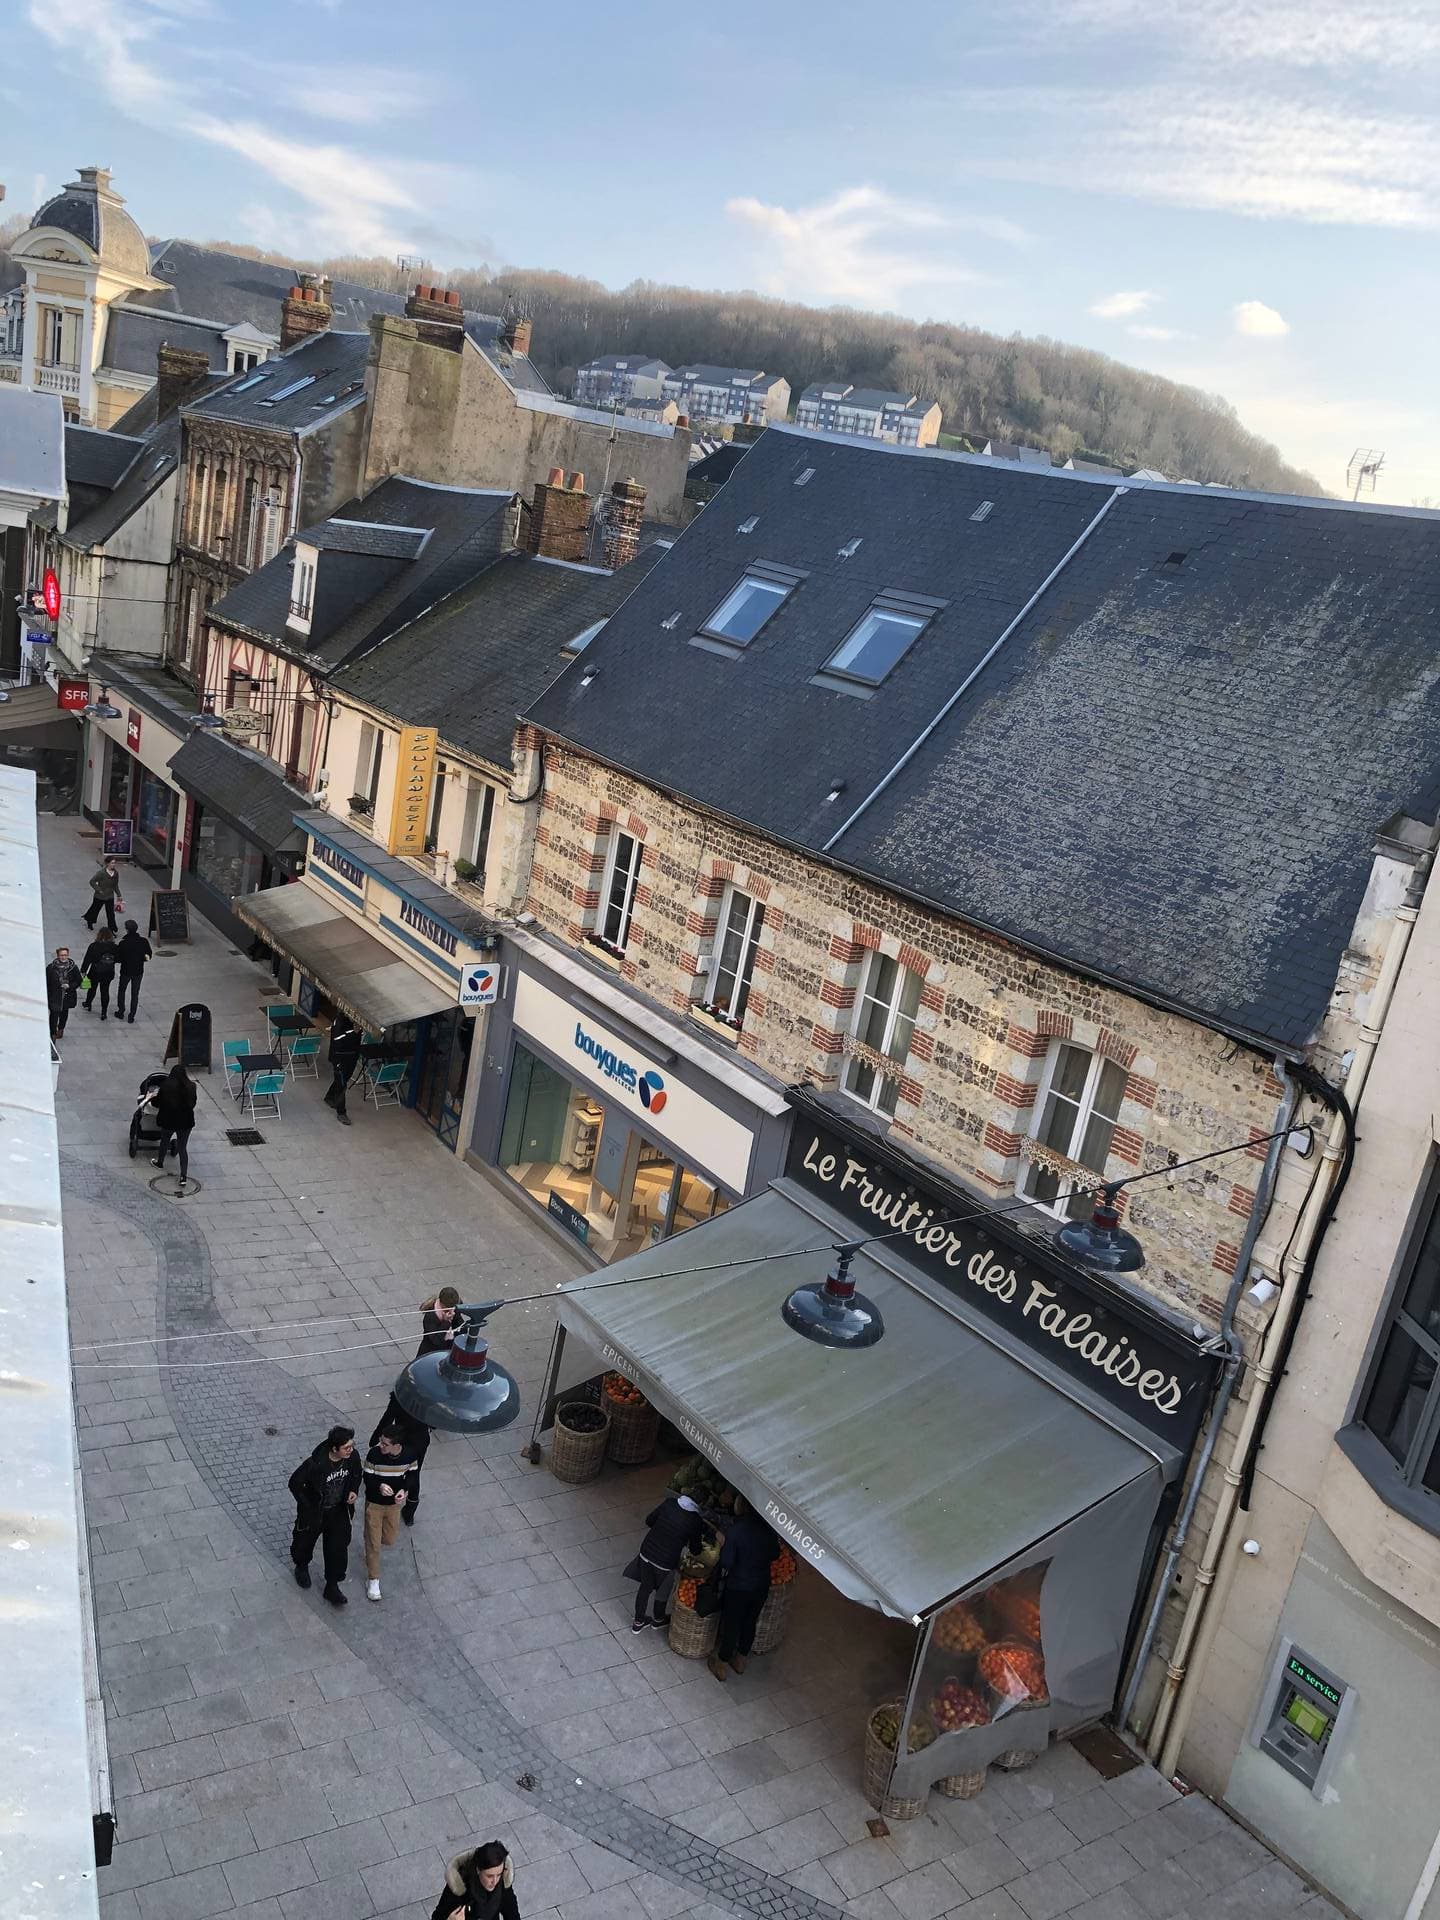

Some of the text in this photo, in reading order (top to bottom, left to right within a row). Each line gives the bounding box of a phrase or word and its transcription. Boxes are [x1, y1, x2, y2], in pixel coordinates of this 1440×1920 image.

[65, 689, 89, 701] SFR
[128, 721, 138, 740] SFR
[312, 837, 365, 890] BOULANGERIE
[462, 993, 494, 1003] bouygues
[575, 1022, 638, 1087] bouygues
[802, 1136, 1183, 1416] Le Fruitier des Falaises
[602, 1343, 641, 1382] EPICERIE
[679, 1415, 723, 1464] CREMERIE
[765, 1499, 825, 1560] FROMAGES
[1289, 1659, 1339, 1702] En service
